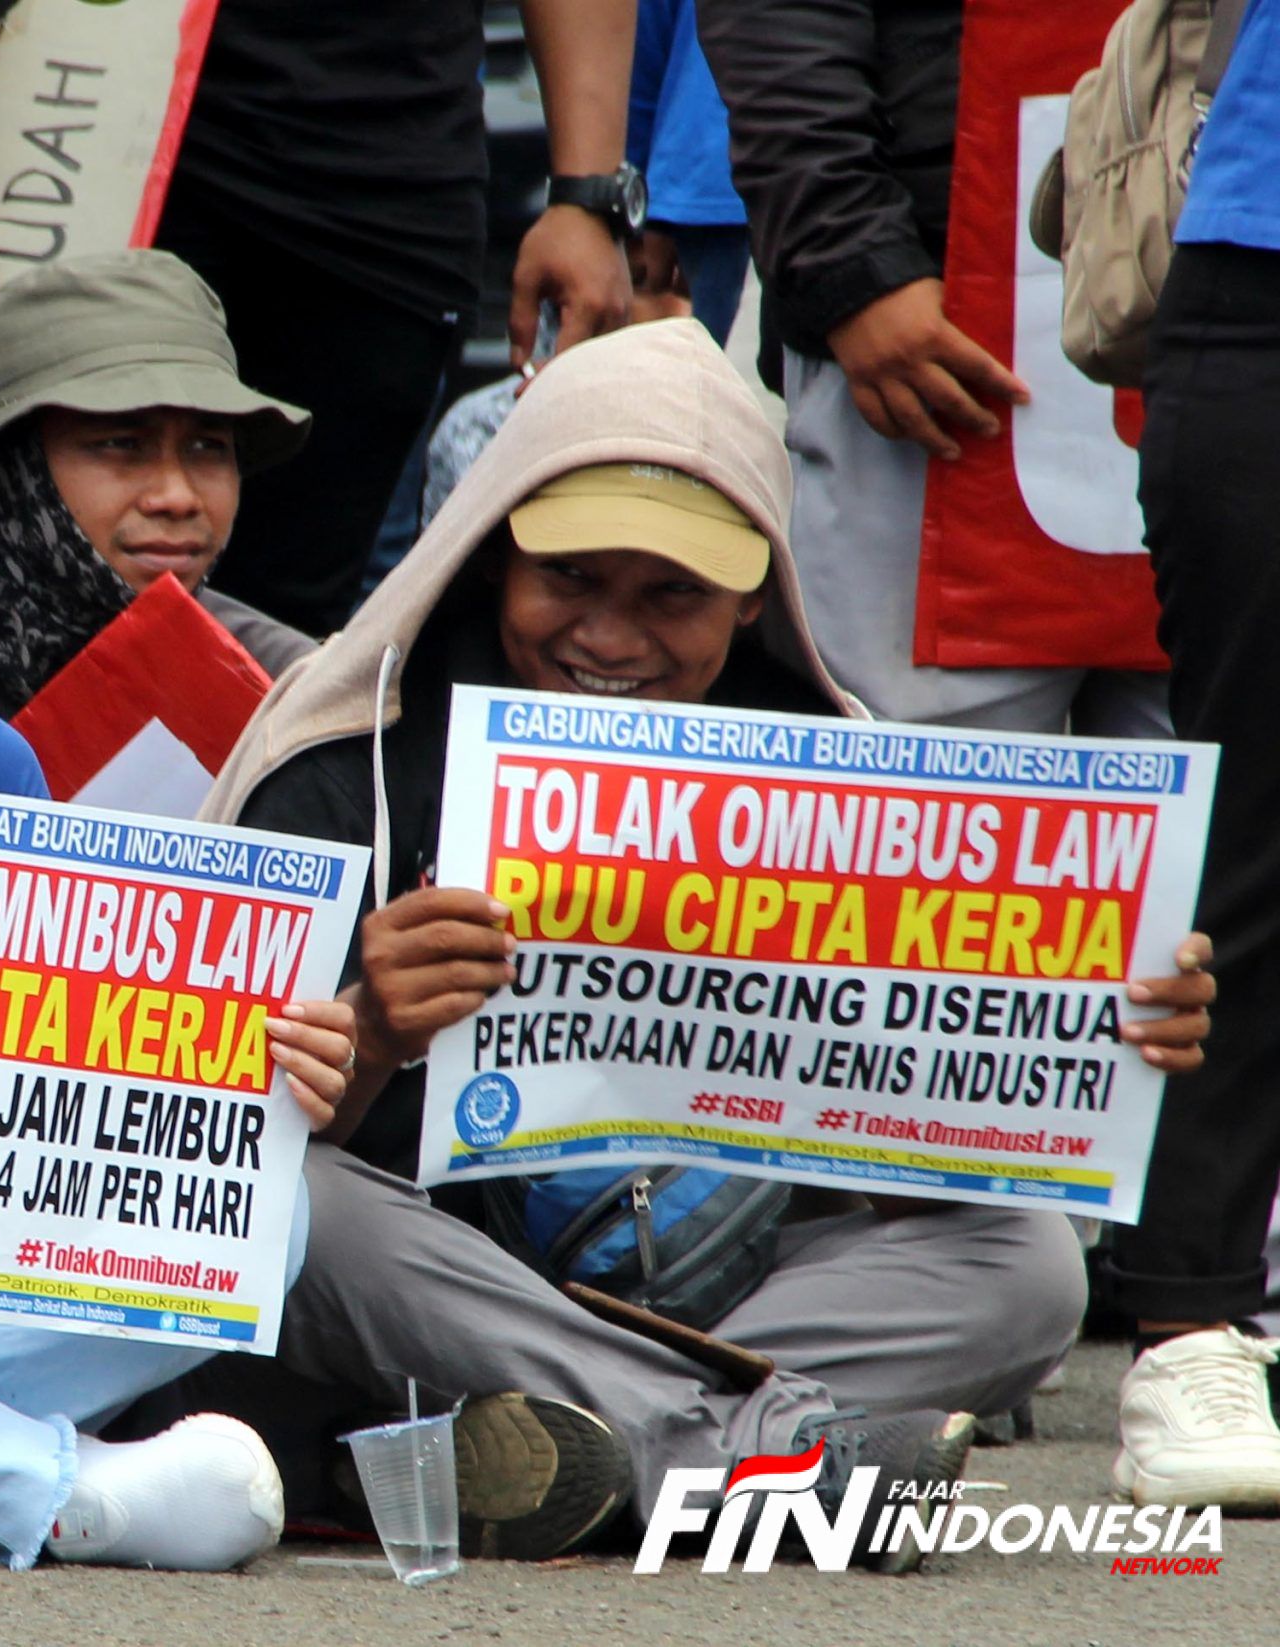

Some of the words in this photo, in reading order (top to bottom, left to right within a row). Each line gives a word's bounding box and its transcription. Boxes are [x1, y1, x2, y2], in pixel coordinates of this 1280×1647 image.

[504, 705, 675, 751] GABUNGAN
[683, 719, 808, 763] SERIKAT
[813, 730, 917, 769] BURUH
[924, 739, 1082, 786] INDONESIA
[1088, 749, 1176, 793] (GSBI)
[32, 814, 121, 854] BURUH
[124, 827, 250, 879] INDONESIA
[254, 846, 331, 894] (GSBI)
[496, 764, 706, 864] TOLAK
[718, 787, 1000, 877] OMNIBUS
[1014, 806, 1153, 890] LAW
[188, 894, 313, 999] LAW
[494, 859, 649, 944] RUU
[664, 873, 870, 963] CIPTA
[890, 887, 1120, 979] KERJA
[85, 976, 268, 1090] KERJA
[487, 952, 866, 1025] UTSOURCING
[884, 982, 1119, 1044] DISEMUA
[473, 1013, 699, 1072] PEKERJAAN
[708, 1026, 798, 1081] DAN
[798, 1039, 917, 1095] JENIS
[926, 1051, 1116, 1111] INDUSTRI
[94, 1086, 264, 1171] LEMBUR
[689, 1092, 785, 1126] #GSBI
[816, 1108, 1092, 1157] #TolakOmnibusLaw
[23, 1155, 96, 1219] JAM
[97, 1165, 164, 1226] PER
[172, 1177, 253, 1239] HARI
[17, 1238, 239, 1294] #TolakOmnibusLaw
[94, 1287, 212, 1314] Demokratik
